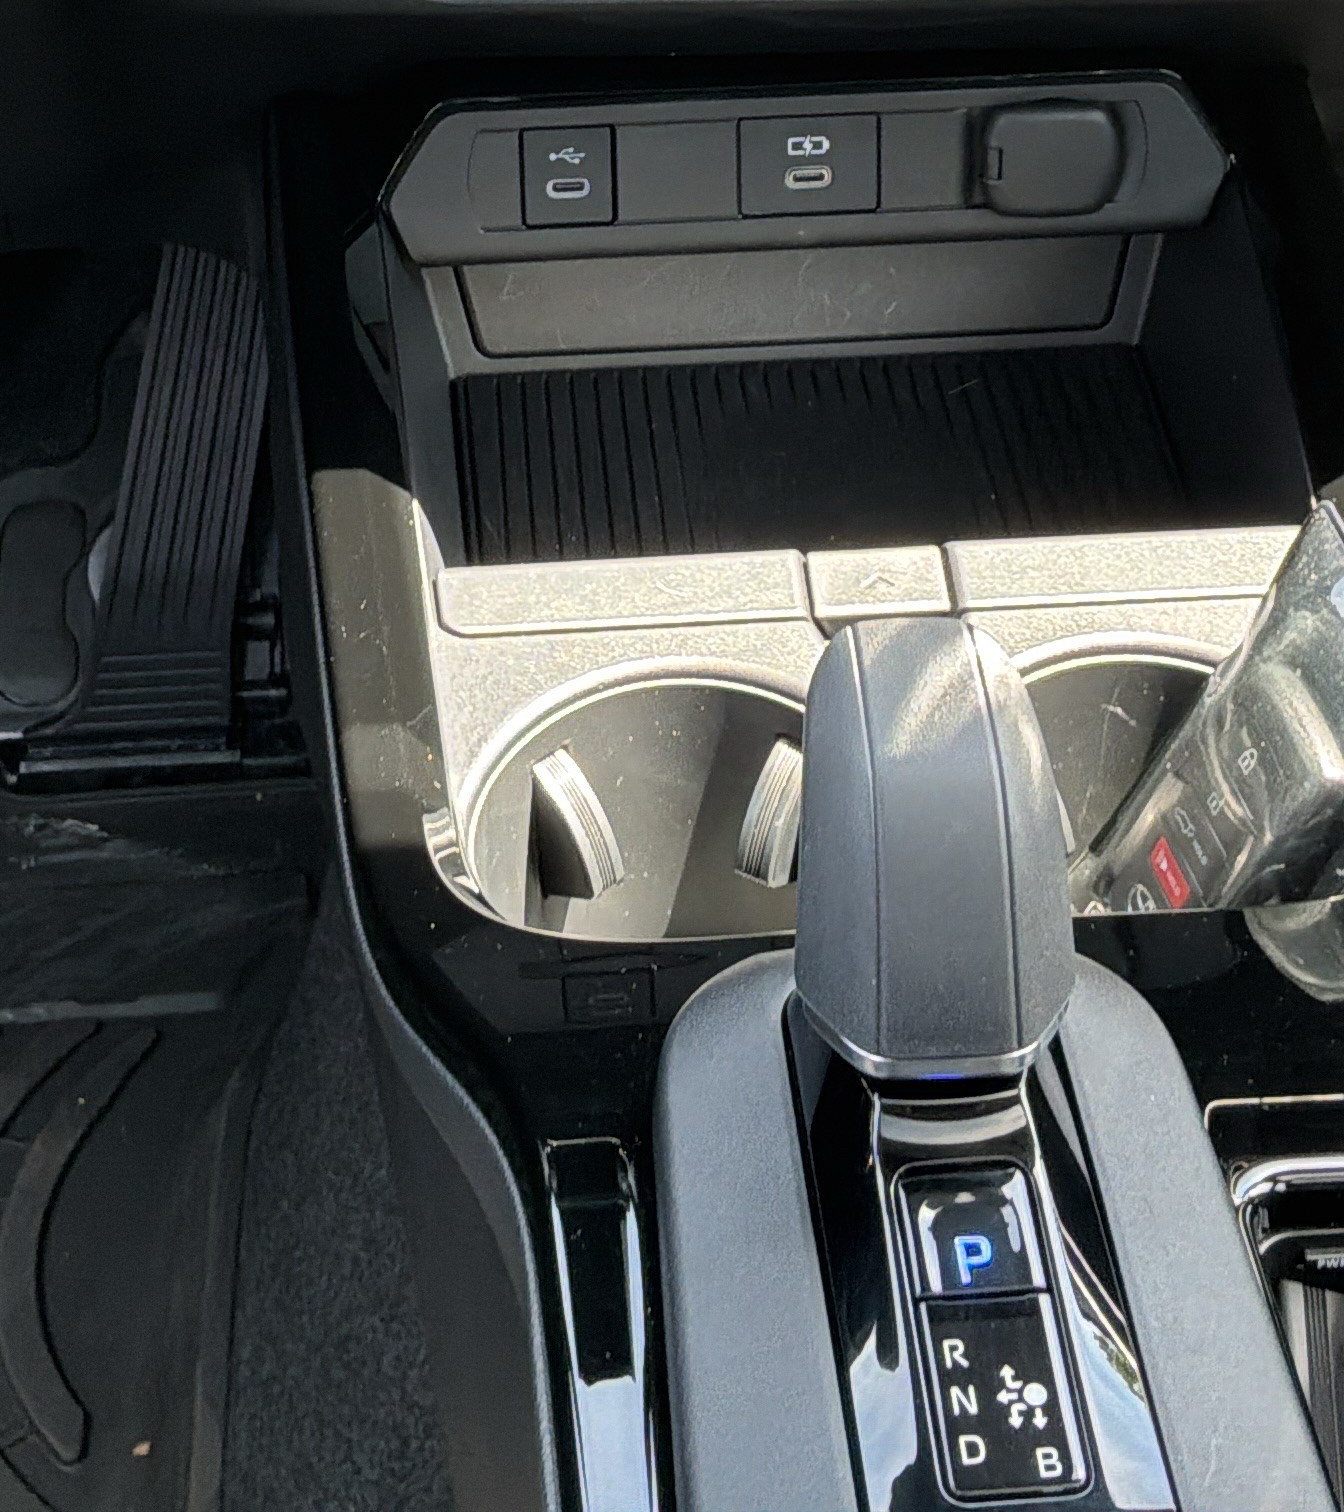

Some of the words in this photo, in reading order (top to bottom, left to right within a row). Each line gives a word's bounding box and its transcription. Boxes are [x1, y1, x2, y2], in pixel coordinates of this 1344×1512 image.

[953, 1235, 993, 1287] P
[942, 1338, 970, 1369] R
[950, 1384, 979, 1417] N
[958, 1434, 987, 1466] D
[1035, 1445, 1064, 1479] B
